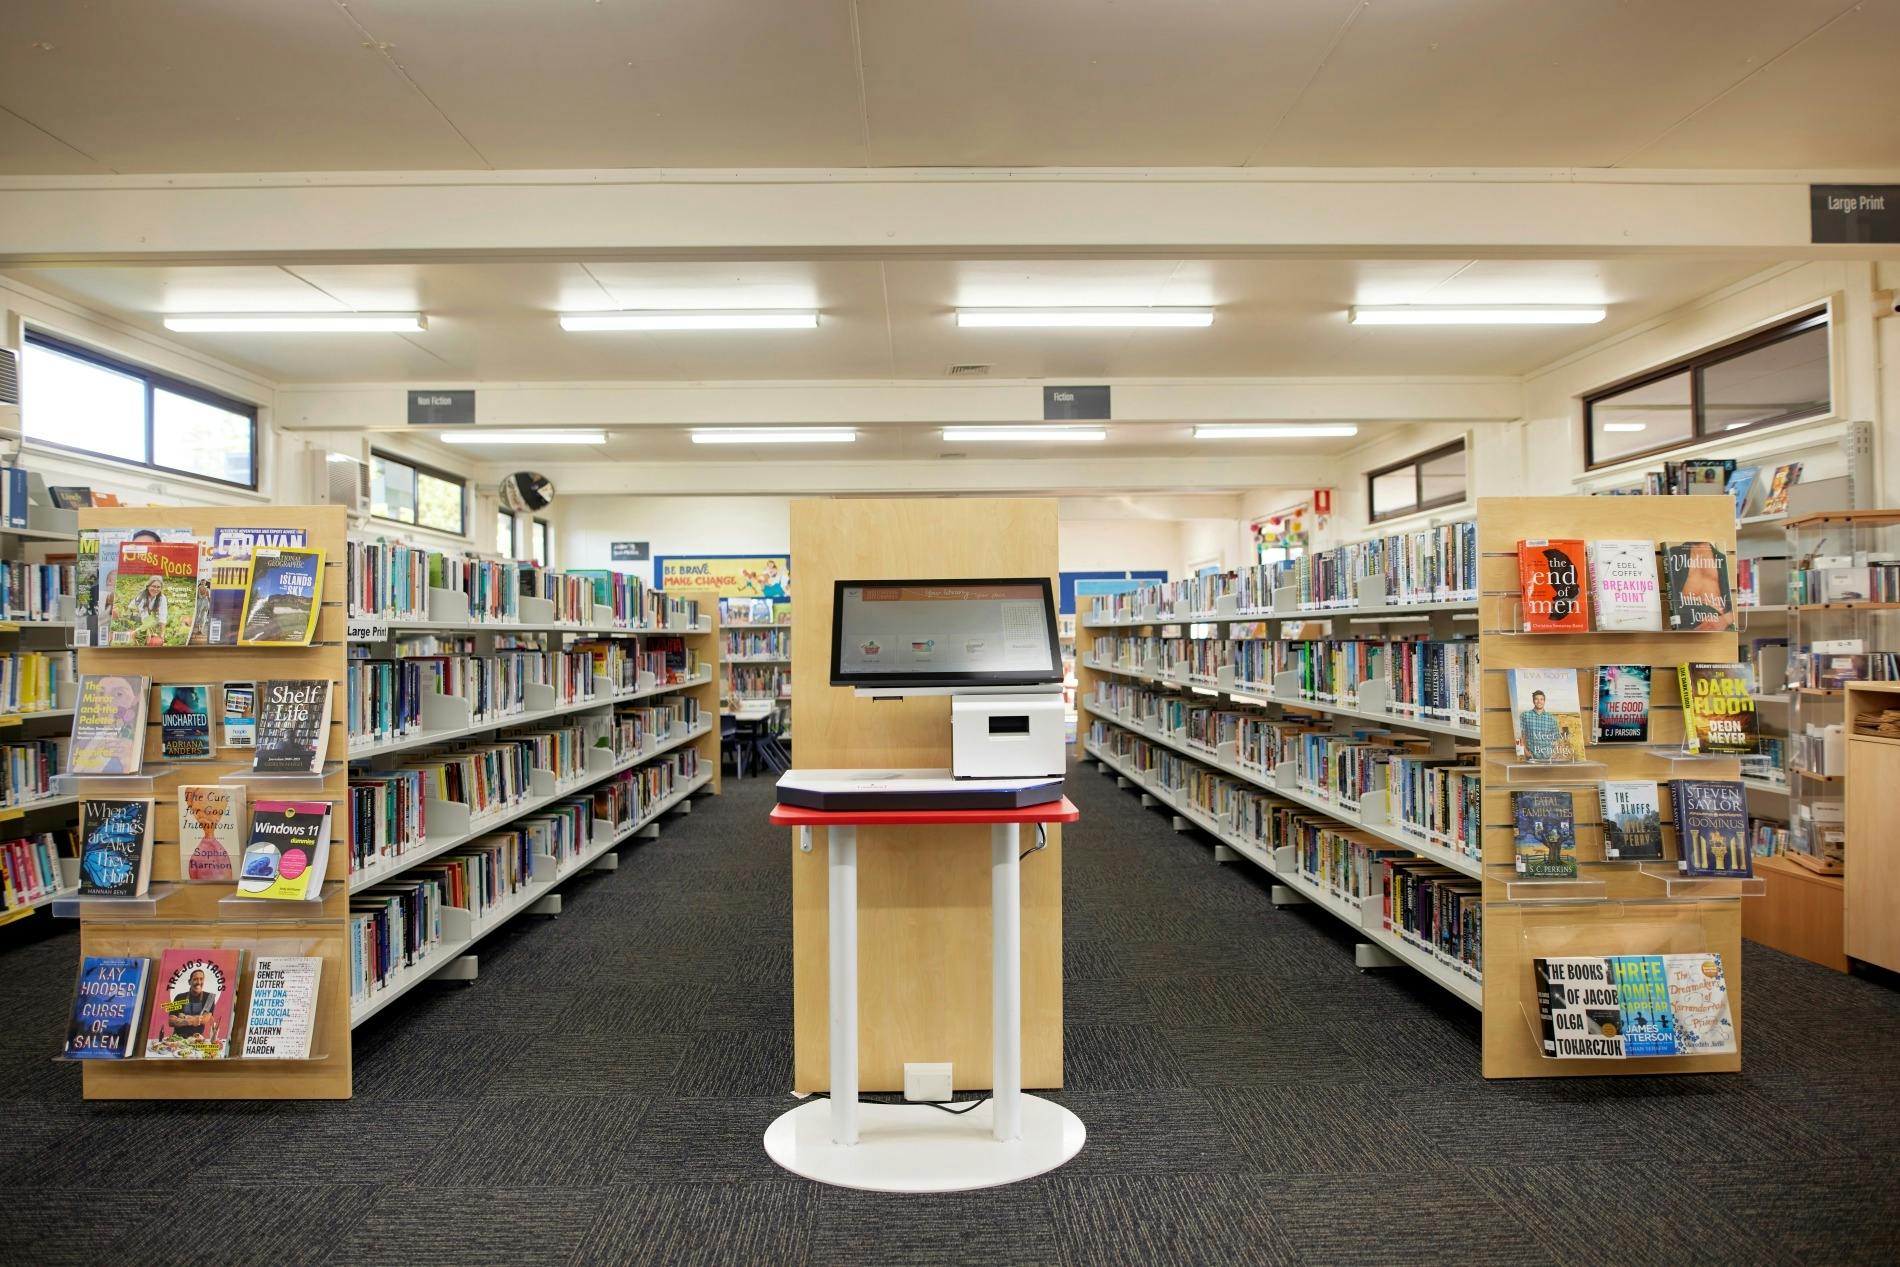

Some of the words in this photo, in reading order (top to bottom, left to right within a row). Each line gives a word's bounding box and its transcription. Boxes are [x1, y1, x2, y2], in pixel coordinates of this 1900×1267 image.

[1828, 195, 1857, 213] Large
[1859, 195, 1885, 210] Print
[161, 556, 193, 577] Roots
[1549, 557, 1567, 568] the
[1671, 554, 1723, 571] Vladimir
[664, 566, 676, 575] BE
[1532, 565, 1577, 586] end
[280, 574, 312, 586] ISLANDS
[664, 577, 692, 586] MAKE
[695, 577, 736, 588] CHANGE
[1603, 580, 1654, 591] BREAKING
[287, 586, 303, 597] SKY
[1557, 586, 1571, 597] of
[1614, 592, 1645, 603] POINT
[1679, 592, 1702, 608] Julia
[1704, 592, 1726, 607] May
[1528, 599, 1581, 614] men
[1690, 608, 1719, 625] Jonas
[347, 626, 371, 639] Large
[372, 626, 387, 637] Print
[85, 682, 102, 690] The
[1680, 678, 1688, 692] DARK
[1696, 678, 1749, 696] DARK
[82, 694, 112, 703] Mirror
[271, 685, 322, 704] Shelf
[80, 705, 99, 714] and
[100, 705, 118, 714] the
[275, 703, 308, 721] Life
[1605, 702, 1620, 712] THE
[1621, 702, 1644, 712] GOOD
[1694, 696, 1755, 716] FLOOD
[79, 715, 114, 725] Palette
[162, 713, 207, 727] UNCHARTED
[1709, 720, 1742, 732] DEON
[1707, 731, 1747, 744] MEYER
[166, 740, 204, 749] ADRIANA
[184, 791, 204, 802] The
[206, 792, 231, 803] Cure
[1615, 792, 1630, 803] THE
[1687, 788, 1740, 799] STEVEN
[1534, 796, 1559, 807] FATAL
[1688, 799, 1743, 812] SAYLOR
[86, 802, 128, 819] When
[184, 808, 201, 818] for
[203, 809, 231, 817] Good
[1522, 807, 1553, 818] FAMILY
[1555, 808, 1574, 818] TIES
[1621, 803, 1650, 815] BLUFFS
[101, 817, 144, 835] Things
[182, 819, 235, 831] Intentions
[255, 821, 306, 836] Windows
[308, 825, 320, 837] 11
[1688, 818, 1745, 829] DOMINUS
[88, 832, 109, 845] are
[290, 838, 316, 847] dummies
[1624, 833, 1650, 847] PERRY
[105, 840, 136, 852] Alive
[194, 847, 228, 859] Sophie
[96, 851, 125, 869] They
[1544, 865, 1573, 873] PERKINS
[102, 870, 135, 884] Hum
[259, 961, 271, 970] THE
[1615, 961, 1664, 982] HREE
[99, 967, 127, 981] KAY
[166, 958, 202, 992] TREJO'S
[206, 960, 227, 992] TACOS
[257, 971, 285, 979] GENETIC
[1547, 964, 1566, 980] THE
[1567, 964, 1604, 980] BOOKS
[81, 982, 136, 997] HOOPER
[255, 980, 285, 989] LOTTERY
[254, 989, 271, 998] WHY
[272, 989, 287, 998] DNA
[1567, 989, 1580, 1005] OF
[1583, 989, 1619, 1005] JACOB
[253, 999, 284, 1007] MATTERS
[1620, 1001, 1668, 1013] SAPPEAR
[82, 1003, 126, 1017] CURSE
[251, 1008, 265, 1017] FOR
[266, 1008, 290, 1017] SOCIAL
[92, 1020, 109, 1033] OF
[250, 1017, 283, 1026] EQUALITY
[1556, 1013, 1584, 1030] OLGA
[248, 1027, 282, 1035] KATHRYN
[1625, 1024, 1659, 1034] JAMES
[74, 1036, 120, 1049] SALEM
[247, 1036, 268, 1045] PAIGE
[1622, 1033, 1673, 1042] ATTERSON
[246, 1045, 275, 1055] HARDEN
[1556, 1038, 1623, 1056] TOKARCZUK
